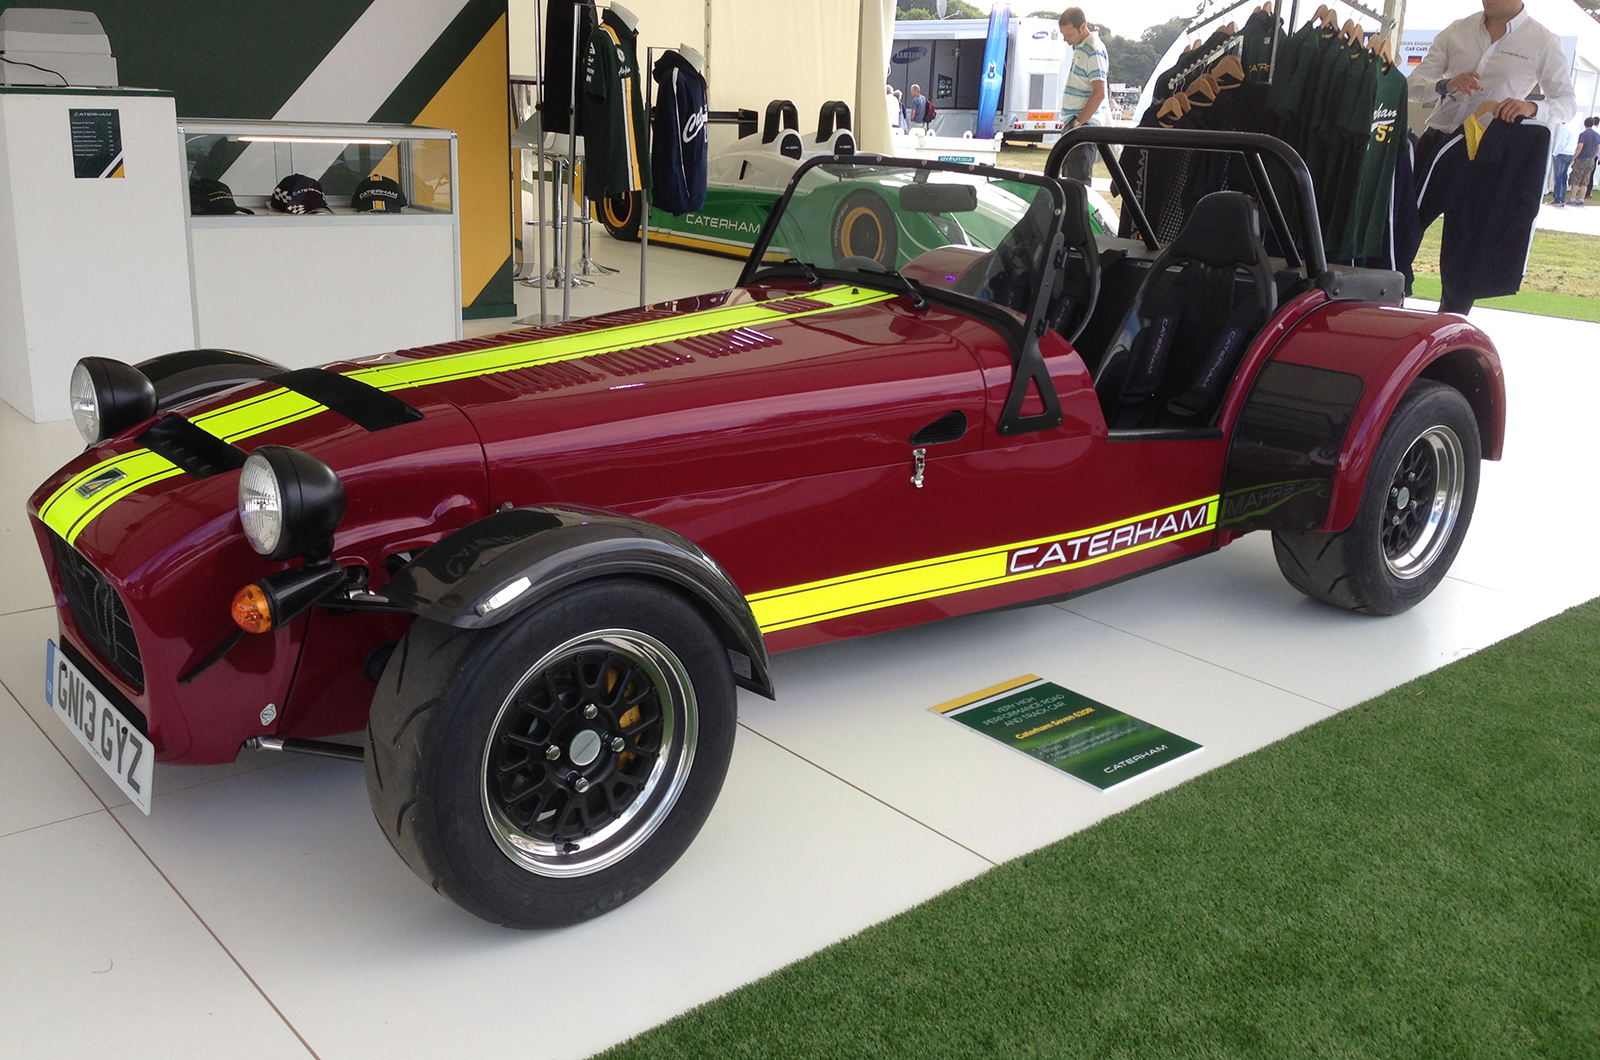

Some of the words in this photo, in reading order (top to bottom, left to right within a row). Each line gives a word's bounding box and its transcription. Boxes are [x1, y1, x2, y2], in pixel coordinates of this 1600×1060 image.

[359, 188, 398, 200] CATERHAM
[685, 213, 761, 235] CATERHAM
[1147, 318, 1169, 375] CATERHAM
[1202, 330, 1236, 388] CATERHAM
[1009, 505, 1207, 573] CATERHAM
[982, 702, 1042, 726] PERFORMANCE
[1041, 693, 1065, 706] ROAD
[993, 702, 1016, 714] VERY
[1015, 696, 1036, 707] HIGH
[1004, 717, 1024, 728] AND
[1022, 707, 1048, 721] TRACK
[1047, 700, 1067, 712] CAR
[58, 660, 97, 743] GN13
[101, 707, 143, 795] GYZ
[1015, 723, 1054, 740] Caterham
[1050, 714, 1076, 727] Seven
[1103, 743, 1168, 774] CATERHAM
